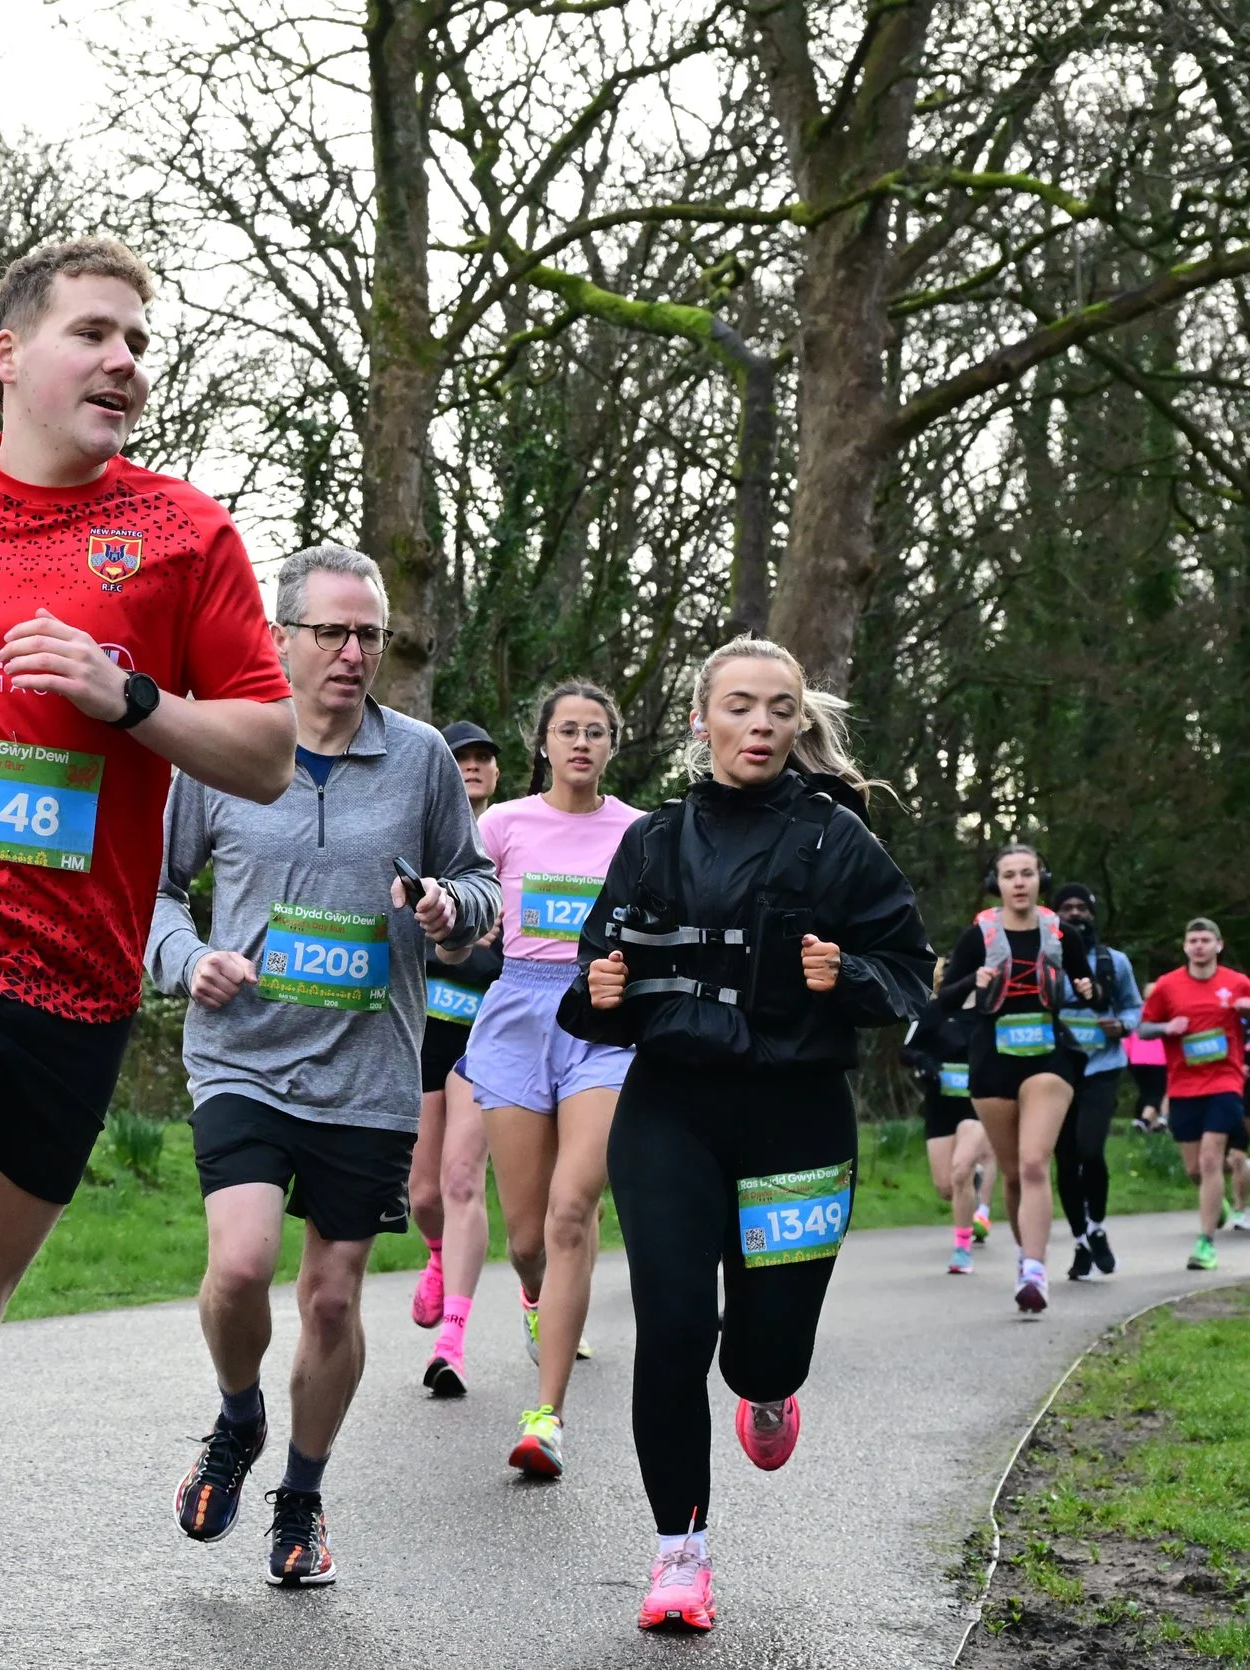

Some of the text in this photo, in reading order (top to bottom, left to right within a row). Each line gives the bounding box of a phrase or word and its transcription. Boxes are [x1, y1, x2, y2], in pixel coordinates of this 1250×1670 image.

[110, 530, 143, 538] PANTEG
[35, 747, 70, 764] Dewi
[61, 855, 85, 871] HM
[542, 873, 564, 882] Dydd
[274, 903, 294, 915] Ras
[295, 906, 323, 920] Dydd
[352, 915, 376, 926] Dewi
[545, 899, 593, 925] 127
[293, 941, 369, 979] 1208
[370, 988, 386, 1000] HM
[433, 986, 479, 1015] 1373
[324, 999, 339, 1007] 1208
[740, 1180, 758, 1190] Ras
[767, 1202, 842, 1241] 1349
